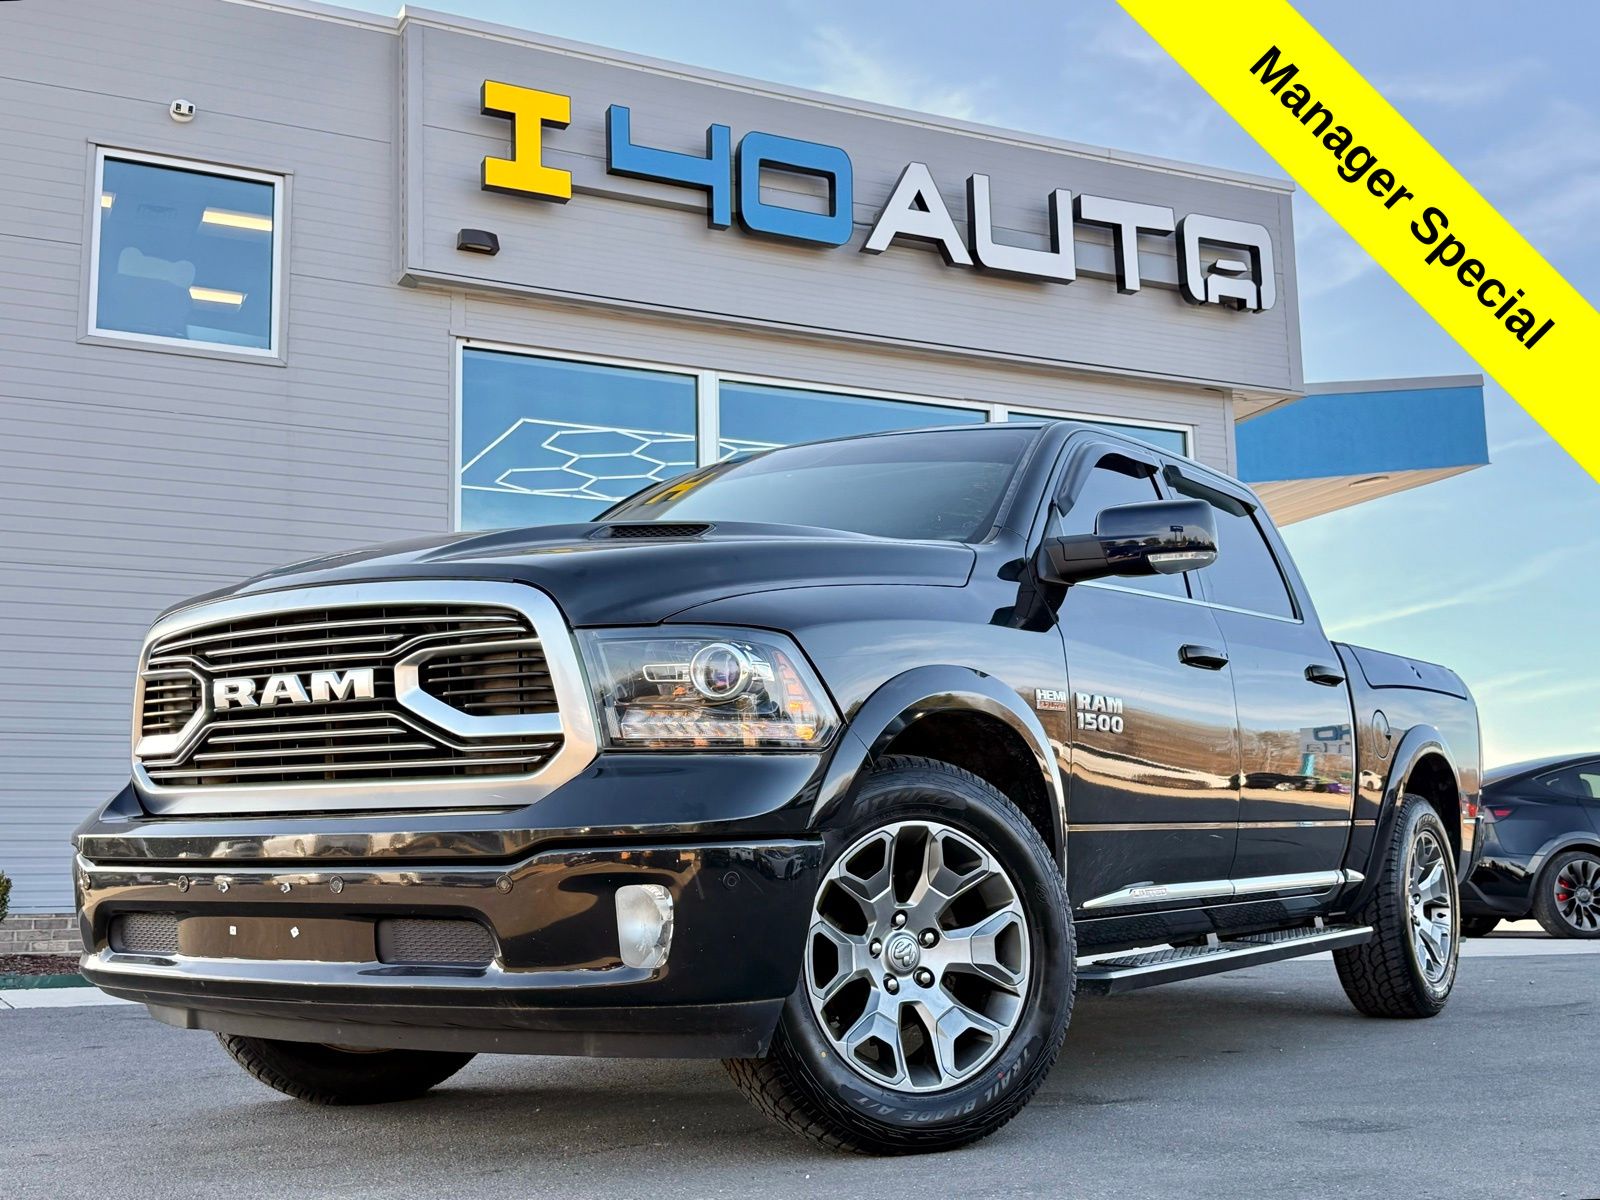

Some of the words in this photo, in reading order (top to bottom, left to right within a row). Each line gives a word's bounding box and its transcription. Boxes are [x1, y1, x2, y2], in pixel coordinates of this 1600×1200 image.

[213, 668, 375, 712] RAM
[1034, 688, 1066, 702] HEMI
[1075, 692, 1123, 714] RAM
[1076, 711, 1124, 734] 1500
[984, 1047, 1031, 1102] TRAIL
[900, 1099, 977, 1122] BLADE
